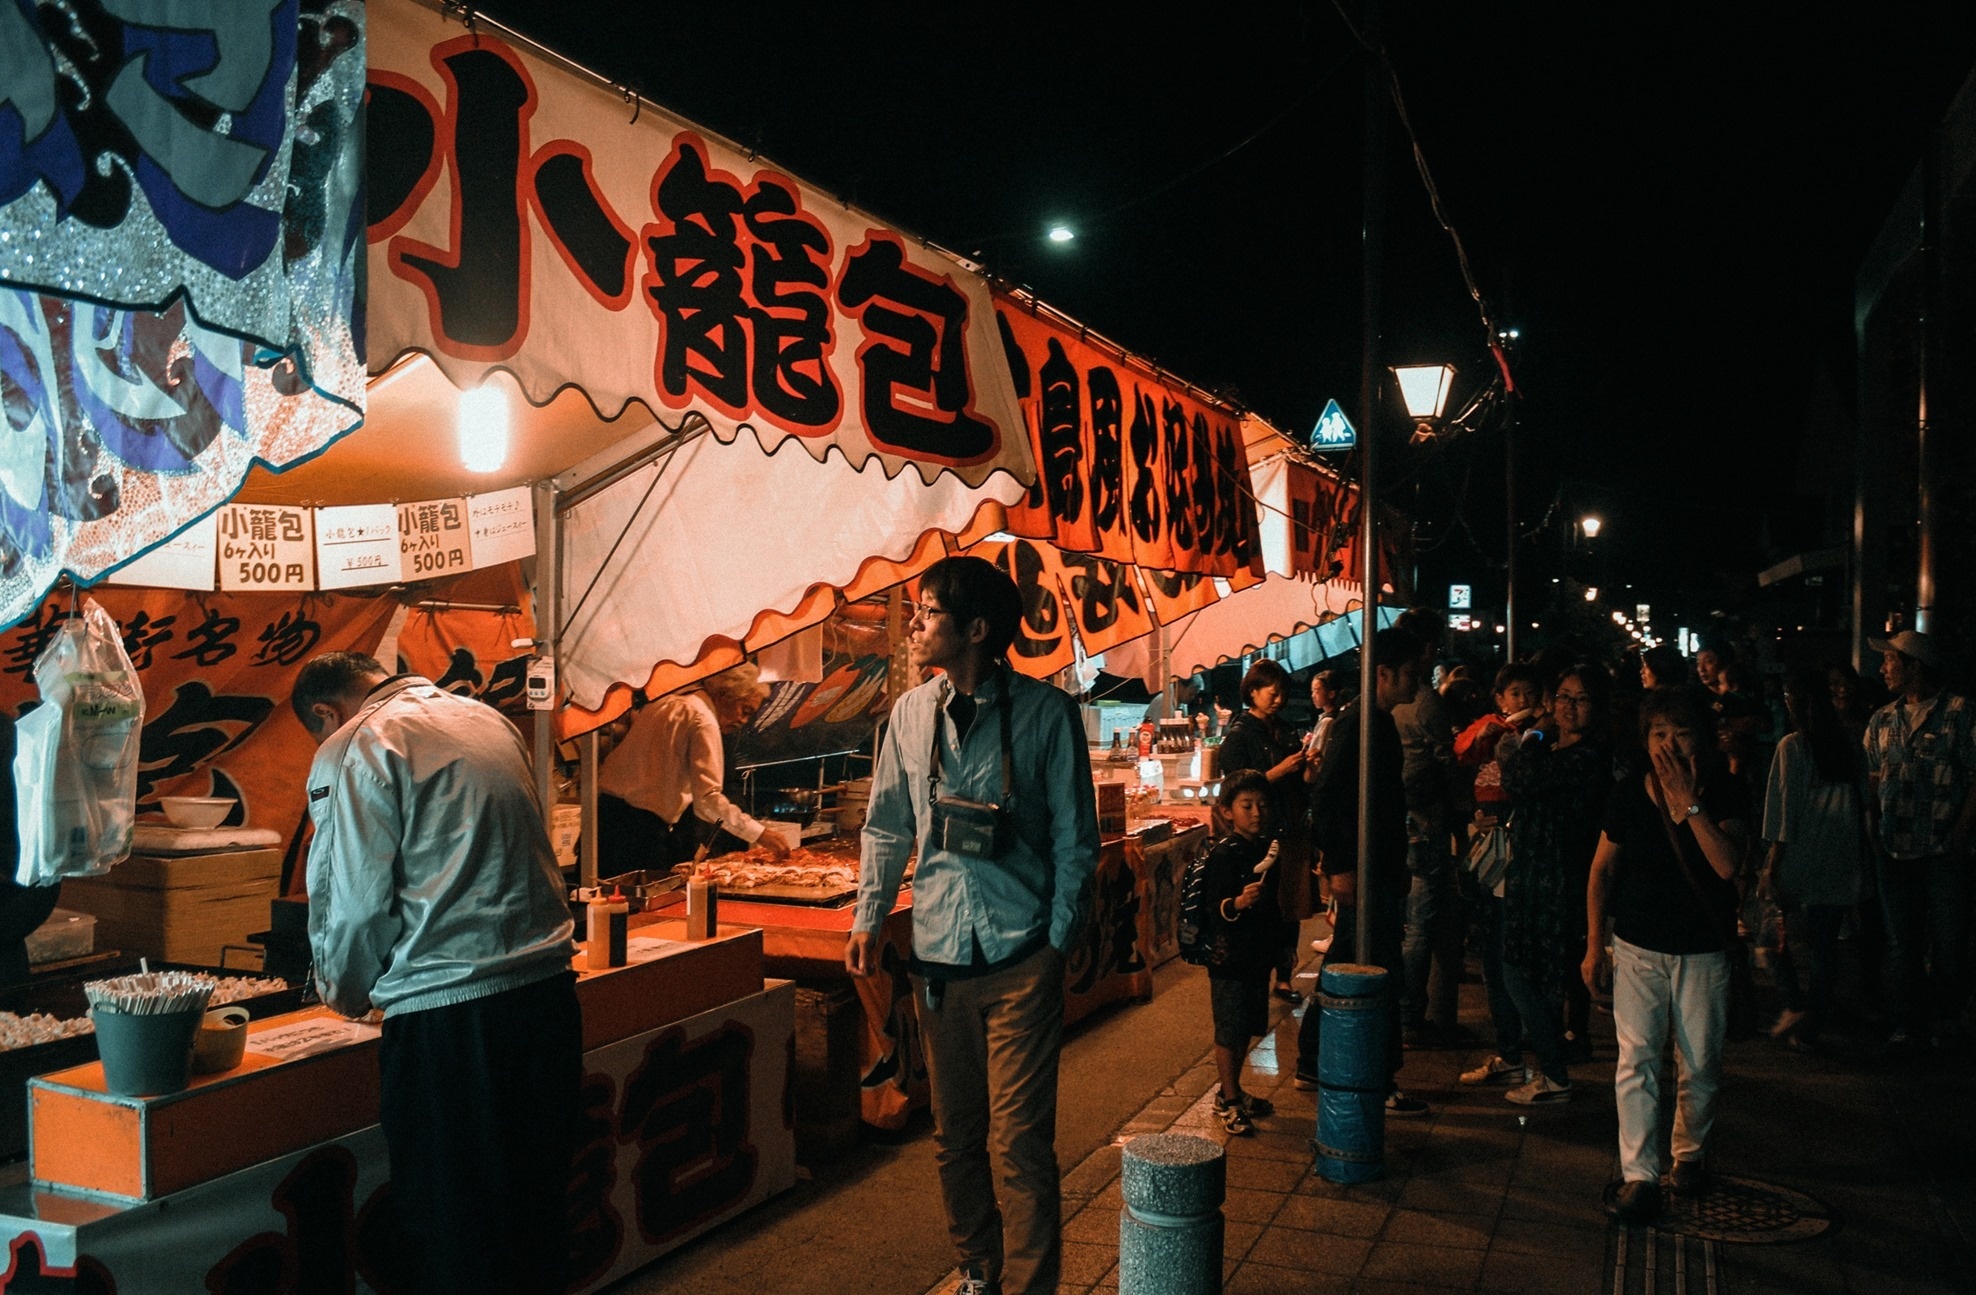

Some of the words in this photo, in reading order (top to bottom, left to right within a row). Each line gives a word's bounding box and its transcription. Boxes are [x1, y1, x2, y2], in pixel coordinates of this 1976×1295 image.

[366, 34, 1000, 467] 小籠包
[221, 507, 304, 541] 小籠包
[398, 503, 461, 536] 小籠包
[240, 562, 304, 584] 500円
[414, 548, 463, 573] 500円
[205, 1018, 759, 1295] 小包
